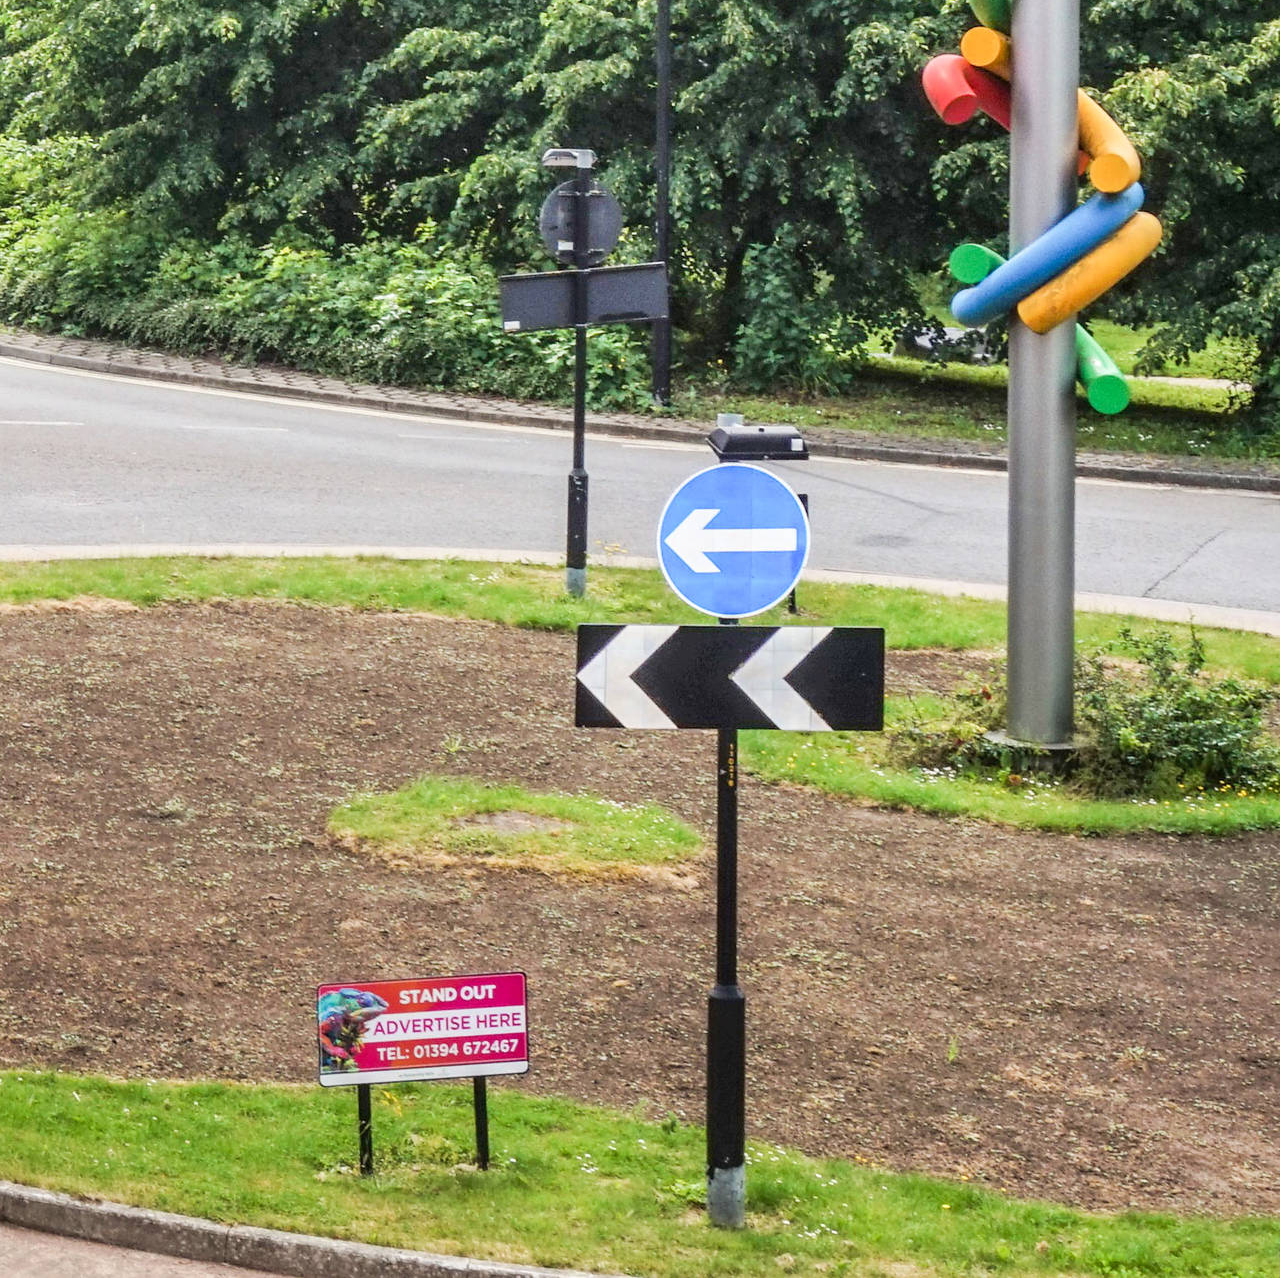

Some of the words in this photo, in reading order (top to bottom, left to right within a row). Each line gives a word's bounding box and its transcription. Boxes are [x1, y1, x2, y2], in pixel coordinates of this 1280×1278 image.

[399, 987, 458, 1005] STAND
[460, 984, 496, 1000] OUT
[373, 1015, 471, 1036] ADVERTISE
[476, 1012, 522, 1029] HERE
[377, 1047, 409, 1061] TEL:
[413, 1042, 459, 1059] 01394
[462, 1038, 519, 1055] 672467
